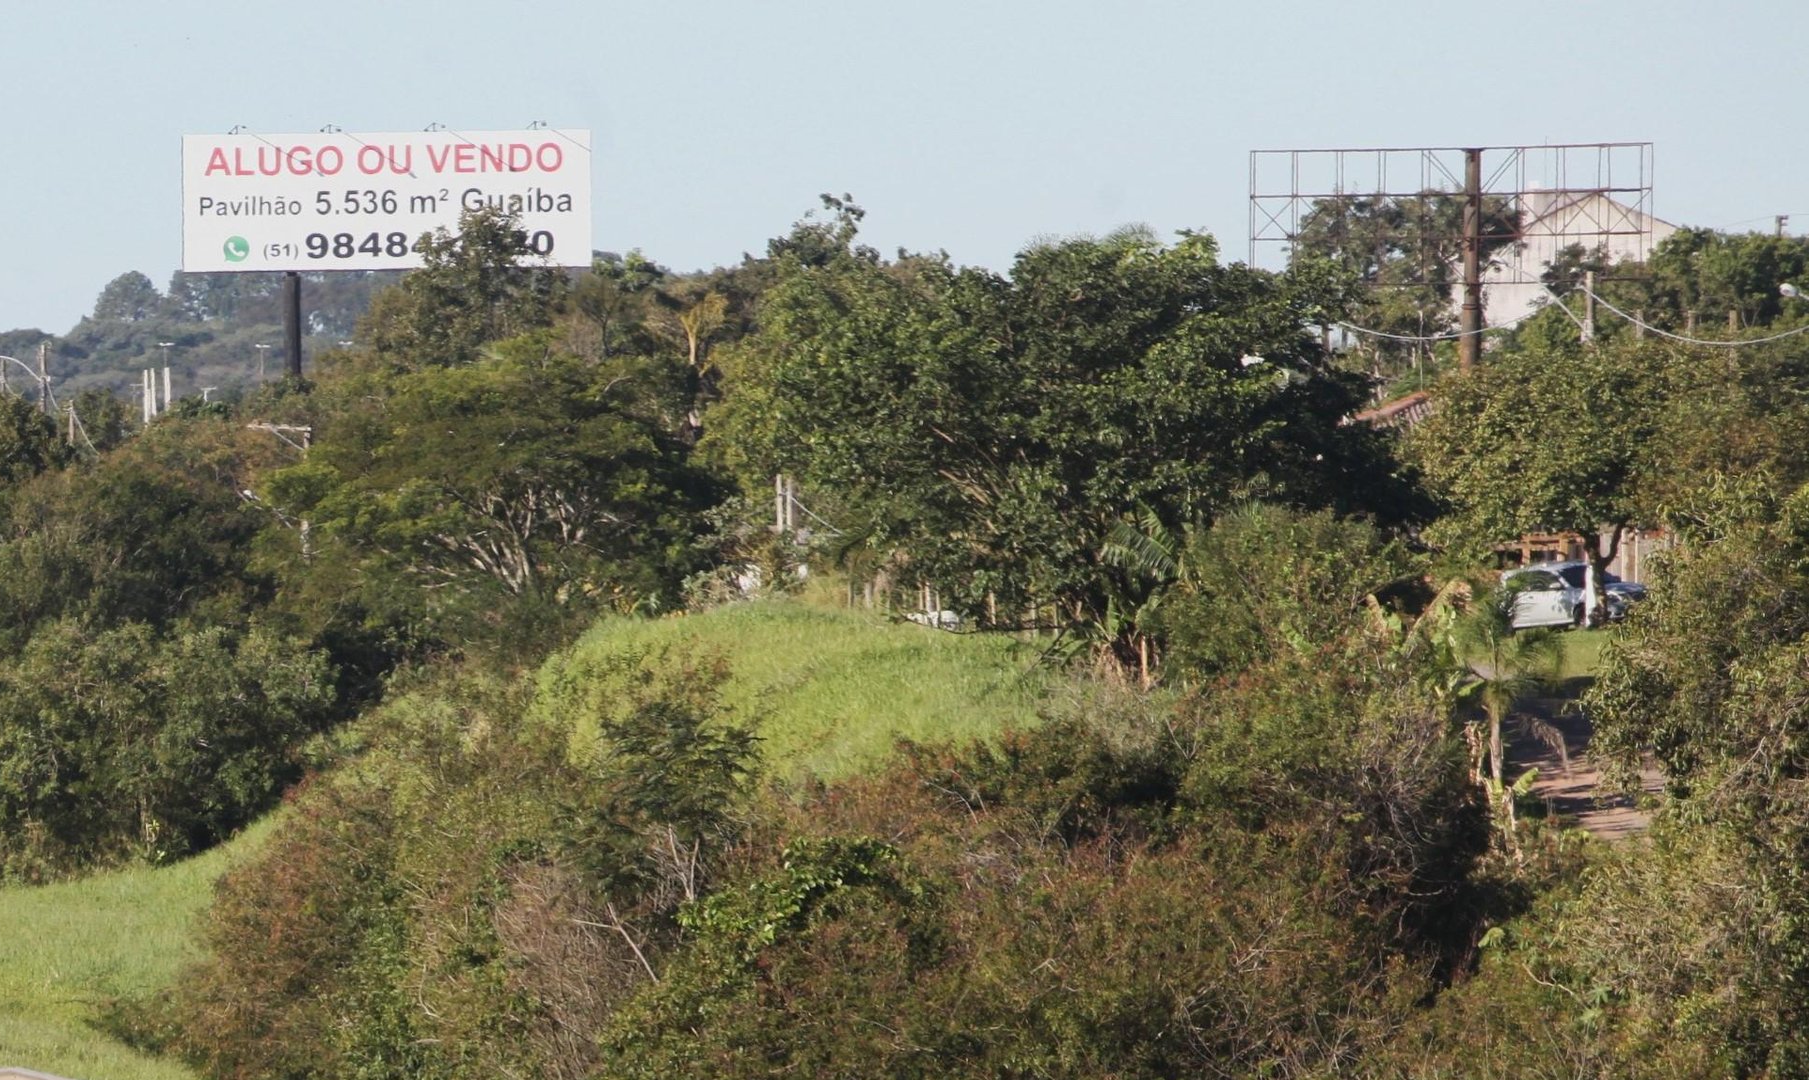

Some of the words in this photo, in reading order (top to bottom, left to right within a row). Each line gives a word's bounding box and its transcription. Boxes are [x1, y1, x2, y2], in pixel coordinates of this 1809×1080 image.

[204, 145, 344, 176] ALUGO
[357, 144, 412, 175] OU
[426, 142, 563, 173] VENDO
[199, 196, 302, 216] Pavilhão
[315, 190, 398, 215] 5.536
[409, 188, 449, 213] m²
[461, 187, 573, 213] Guaíba
[263, 243, 299, 260] (51)
